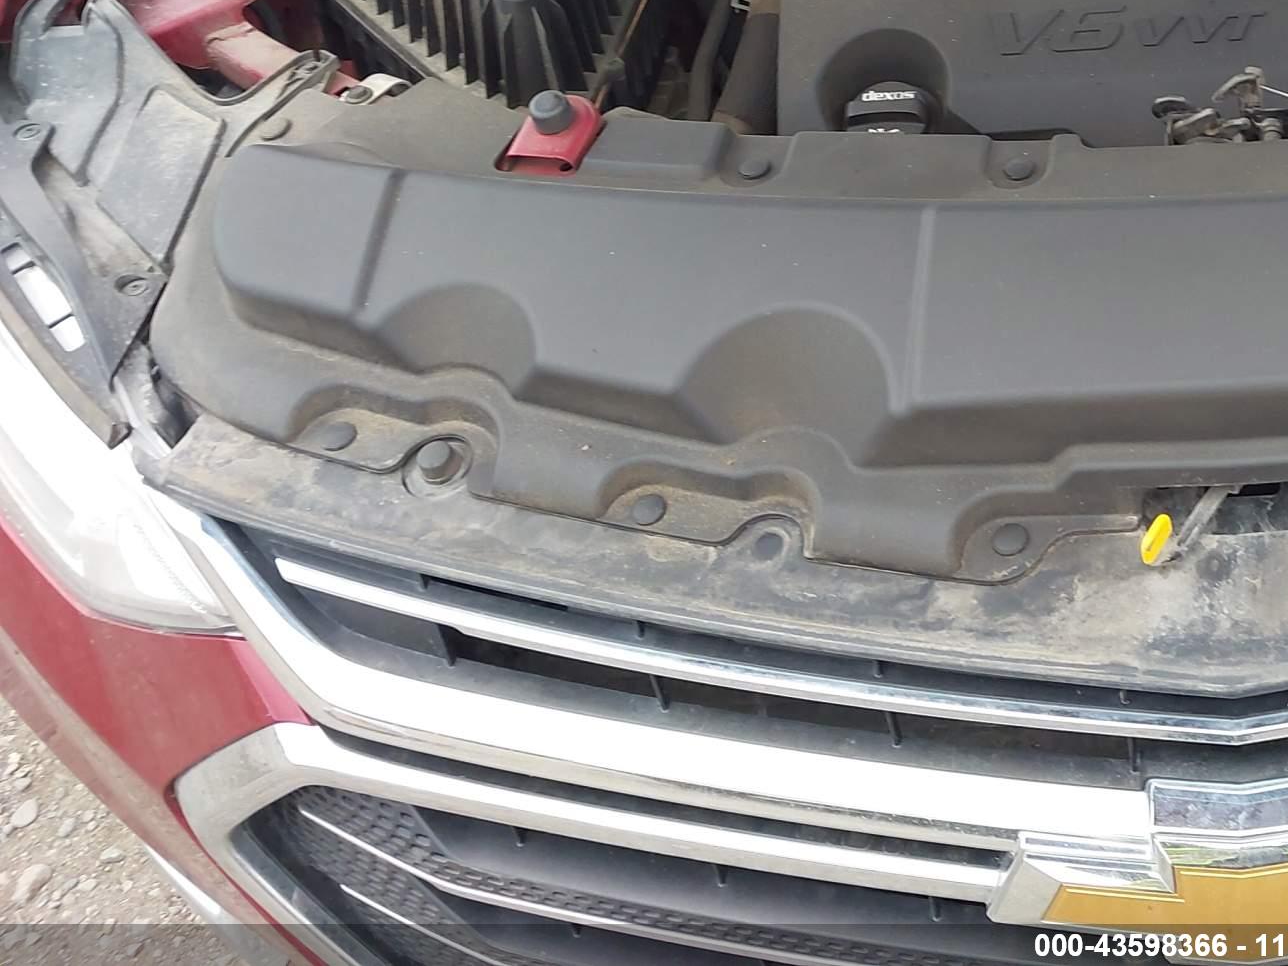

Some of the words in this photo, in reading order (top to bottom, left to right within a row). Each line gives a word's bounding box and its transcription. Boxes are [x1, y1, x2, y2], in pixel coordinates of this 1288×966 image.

[987, 5, 1128, 57] V6
[1134, 10, 1268, 47] VVT
[861, 90, 917, 102] dexos
